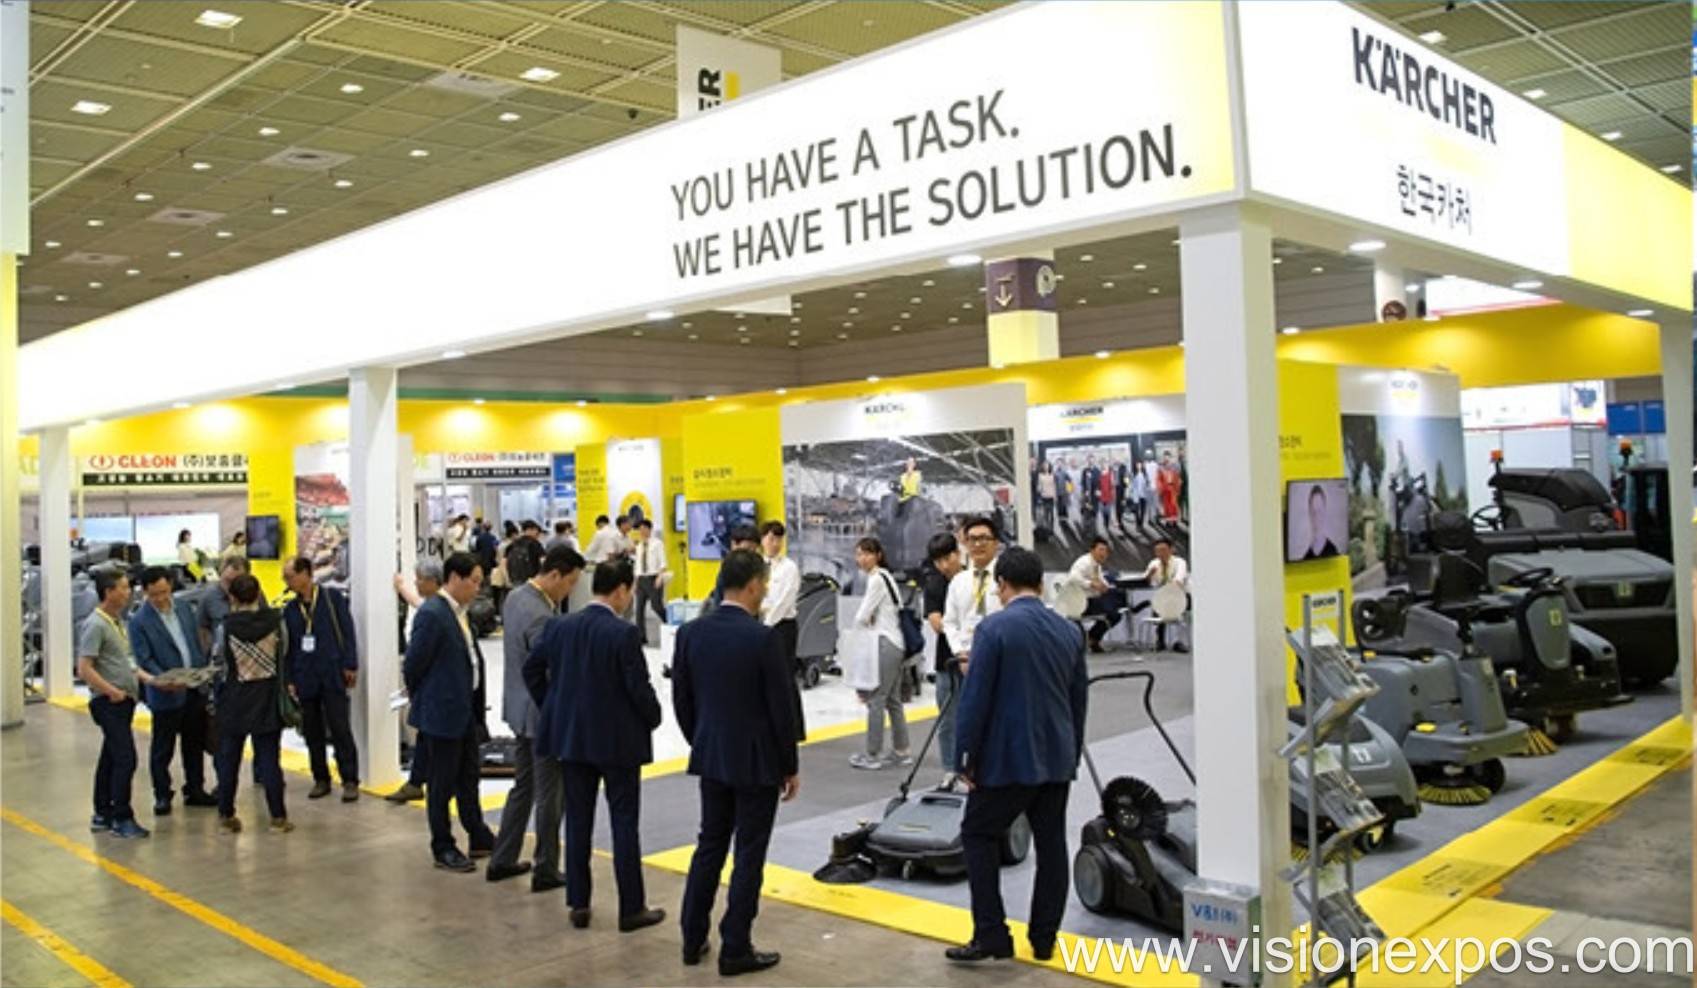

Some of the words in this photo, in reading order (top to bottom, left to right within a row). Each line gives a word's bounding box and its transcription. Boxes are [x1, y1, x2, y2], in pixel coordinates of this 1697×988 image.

[1352, 27, 1497, 145] KÄRCHER
[671, 168, 734, 221] YOU
[747, 139, 839, 202] HAVE
[853, 129, 880, 175] A
[892, 90, 1019, 162] TASK.
[673, 234, 722, 279] WE
[733, 209, 824, 269] HAVE
[836, 188, 912, 245] THE
[928, 123, 1192, 226] SOLUTION.
[118, 454, 177, 468] CLEON
